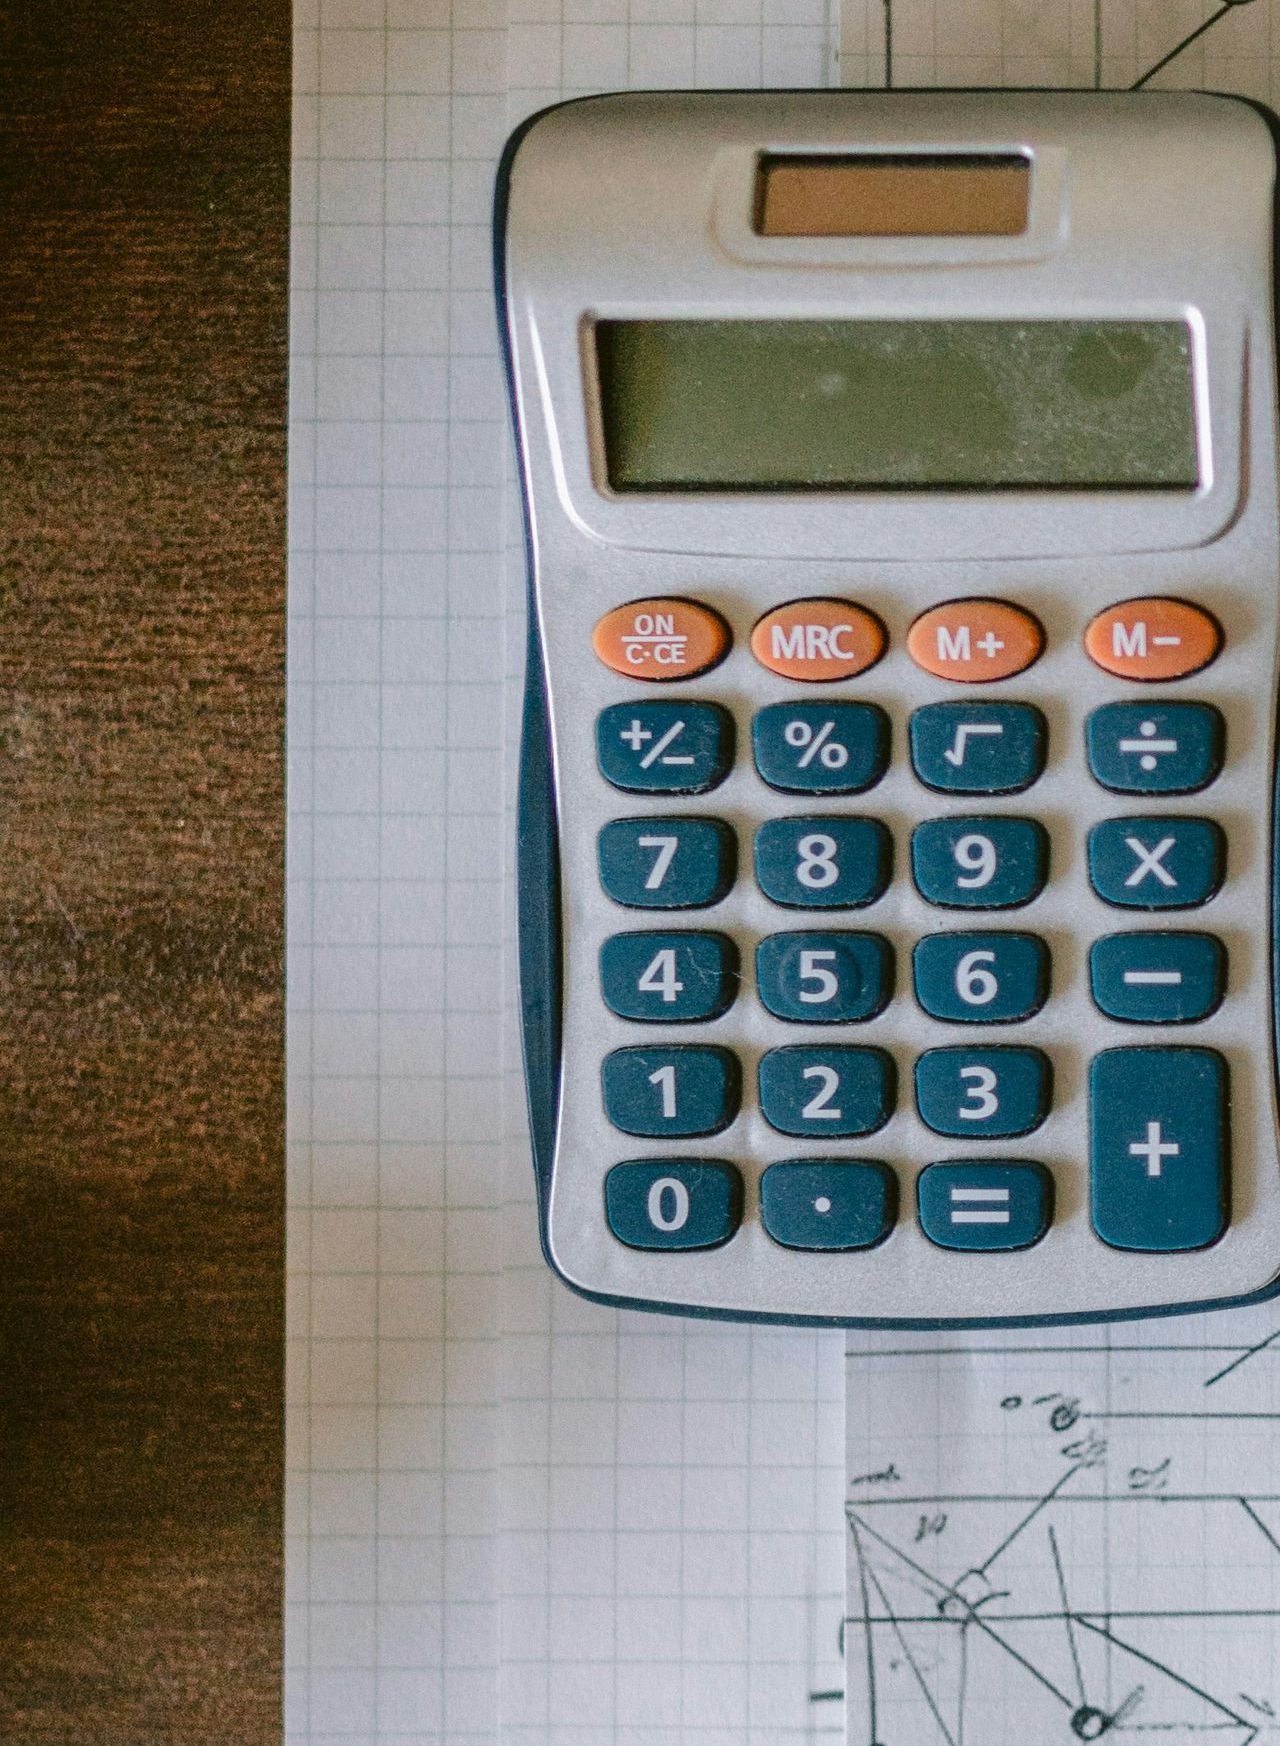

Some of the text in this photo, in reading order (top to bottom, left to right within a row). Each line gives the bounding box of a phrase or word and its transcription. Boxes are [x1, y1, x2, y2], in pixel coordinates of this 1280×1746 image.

[633, 614, 675, 637] ON
[771, 624, 855, 661] MRC
[936, 626, 1005, 663] M+
[785, 720, 850, 771] %
[639, 835, 679, 891] 7
[797, 834, 840, 890] 8
[954, 835, 998, 890] 9
[639, 950, 685, 1003] 4
[800, 951, 839, 1005] 5
[956, 951, 999, 1006] 6
[643, 1063, 678, 1119] 1
[802, 1065, 843, 1120] 2
[959, 1066, 1000, 1121] 3
[1129, 1122, 1180, 1177] +
[648, 1177, 690, 1233] 0
